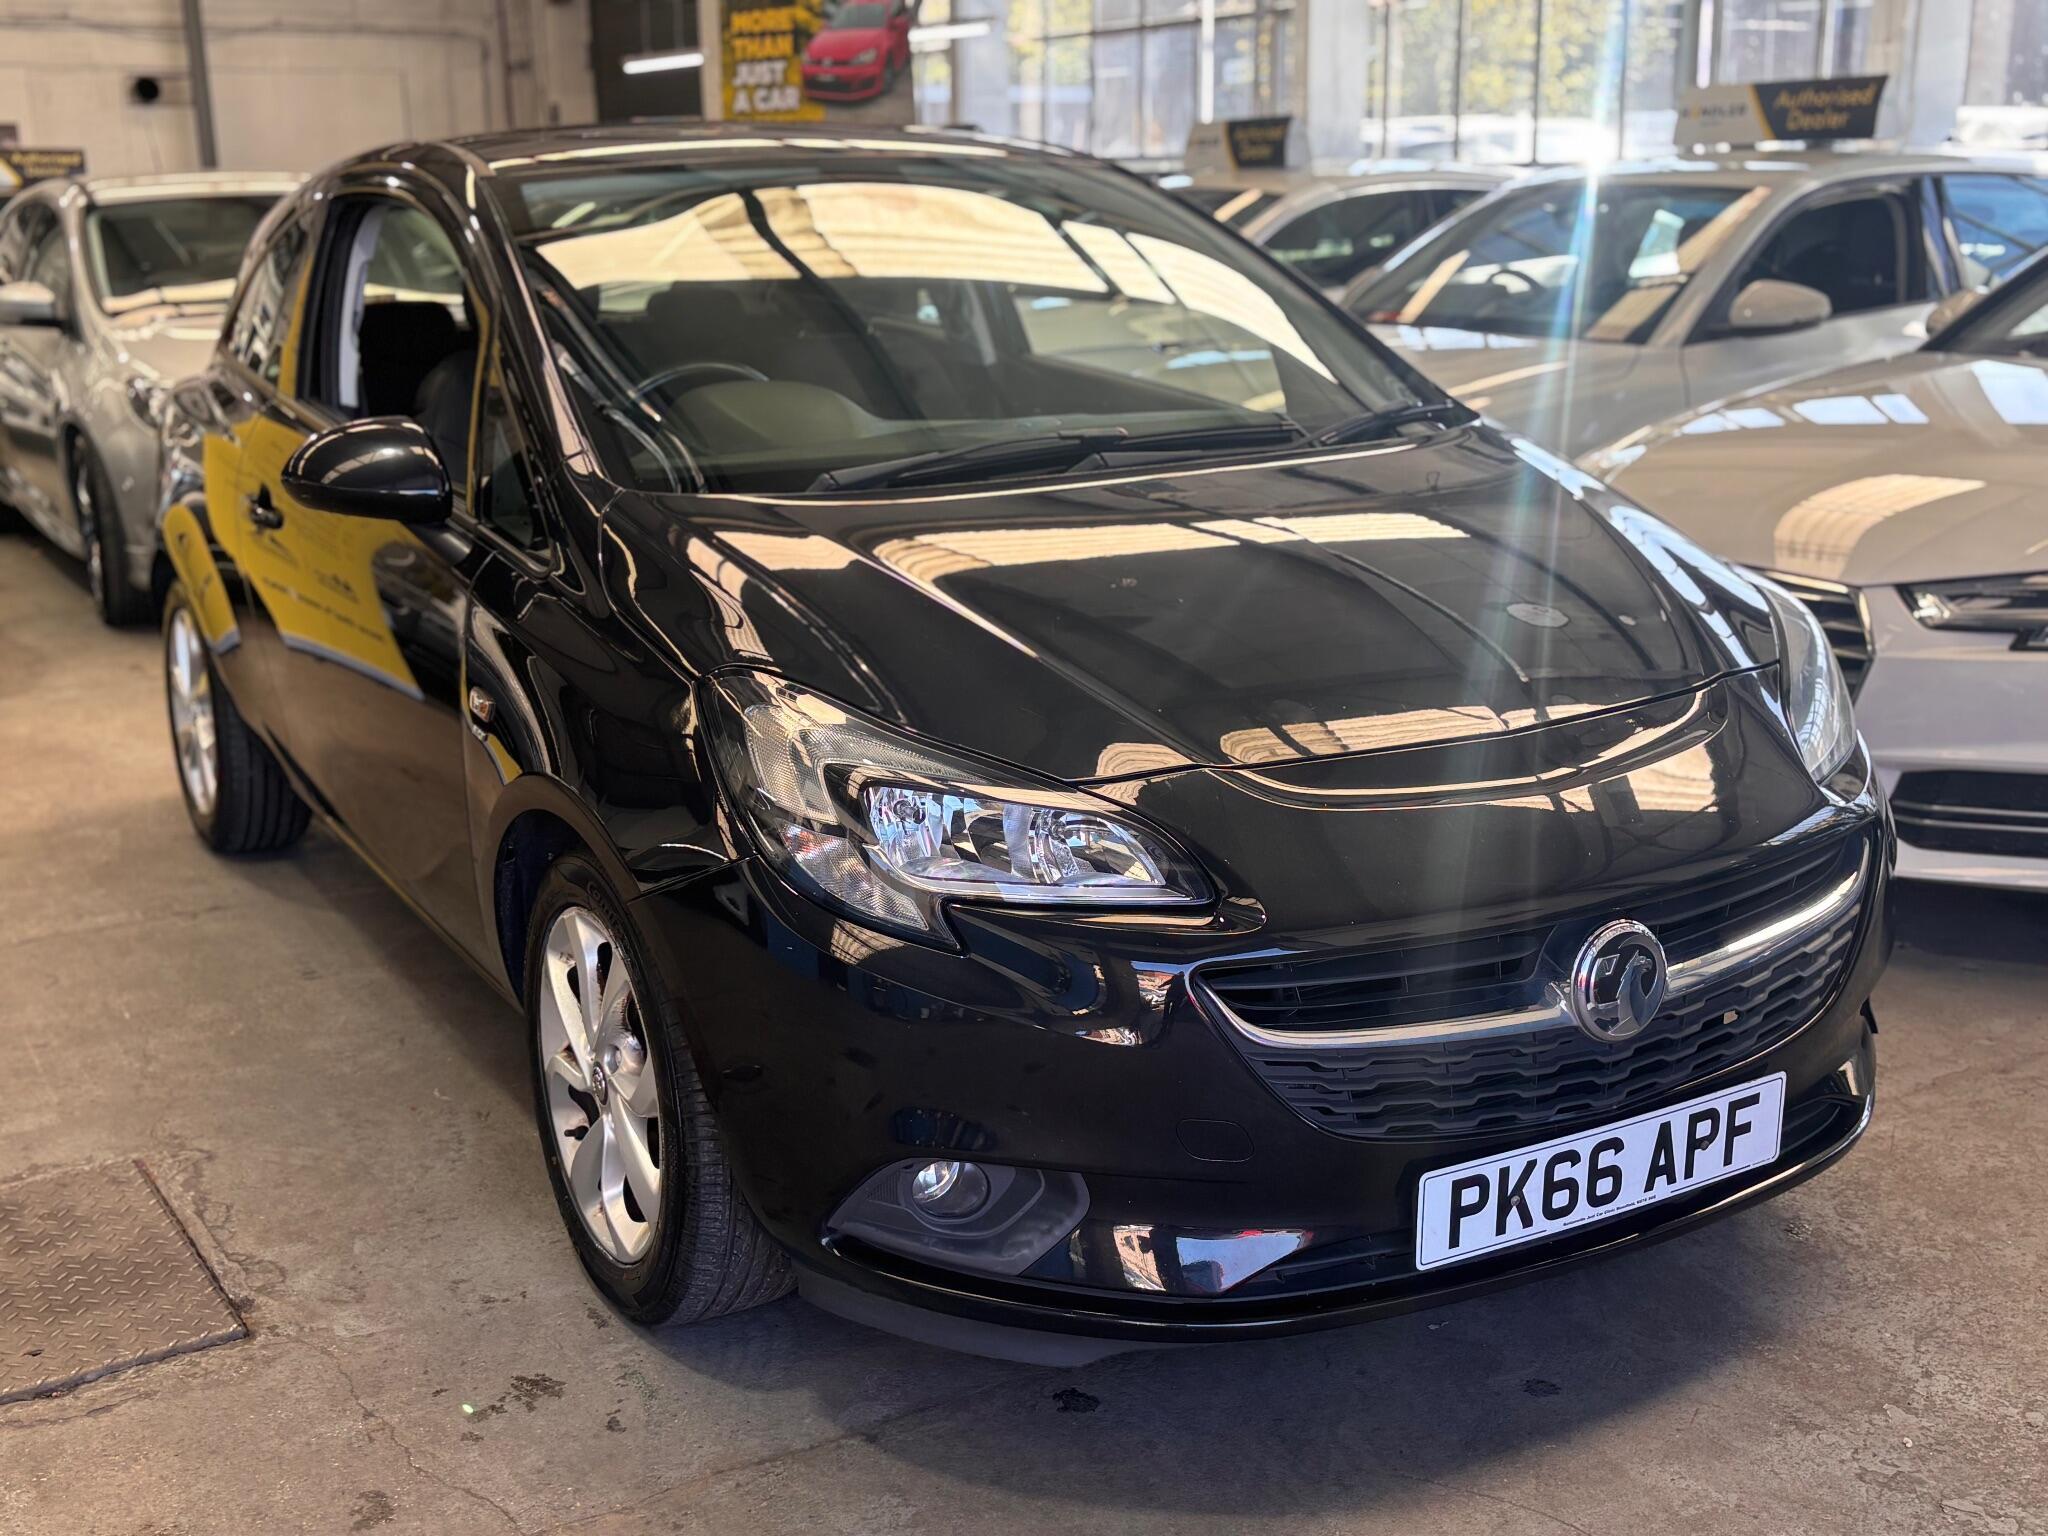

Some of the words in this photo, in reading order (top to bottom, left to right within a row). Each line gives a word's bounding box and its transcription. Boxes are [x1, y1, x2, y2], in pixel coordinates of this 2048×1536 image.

[731, 33, 794, 60] THAN
[732, 59, 788, 87] JUST
[732, 88, 751, 114] A
[753, 85, 801, 112] CAR
[1773, 81, 1877, 109] Authorised
[1785, 107, 1851, 131] Dealer
[1448, 1136, 1626, 1250] PK66
[1643, 1092, 1760, 1194] APF
